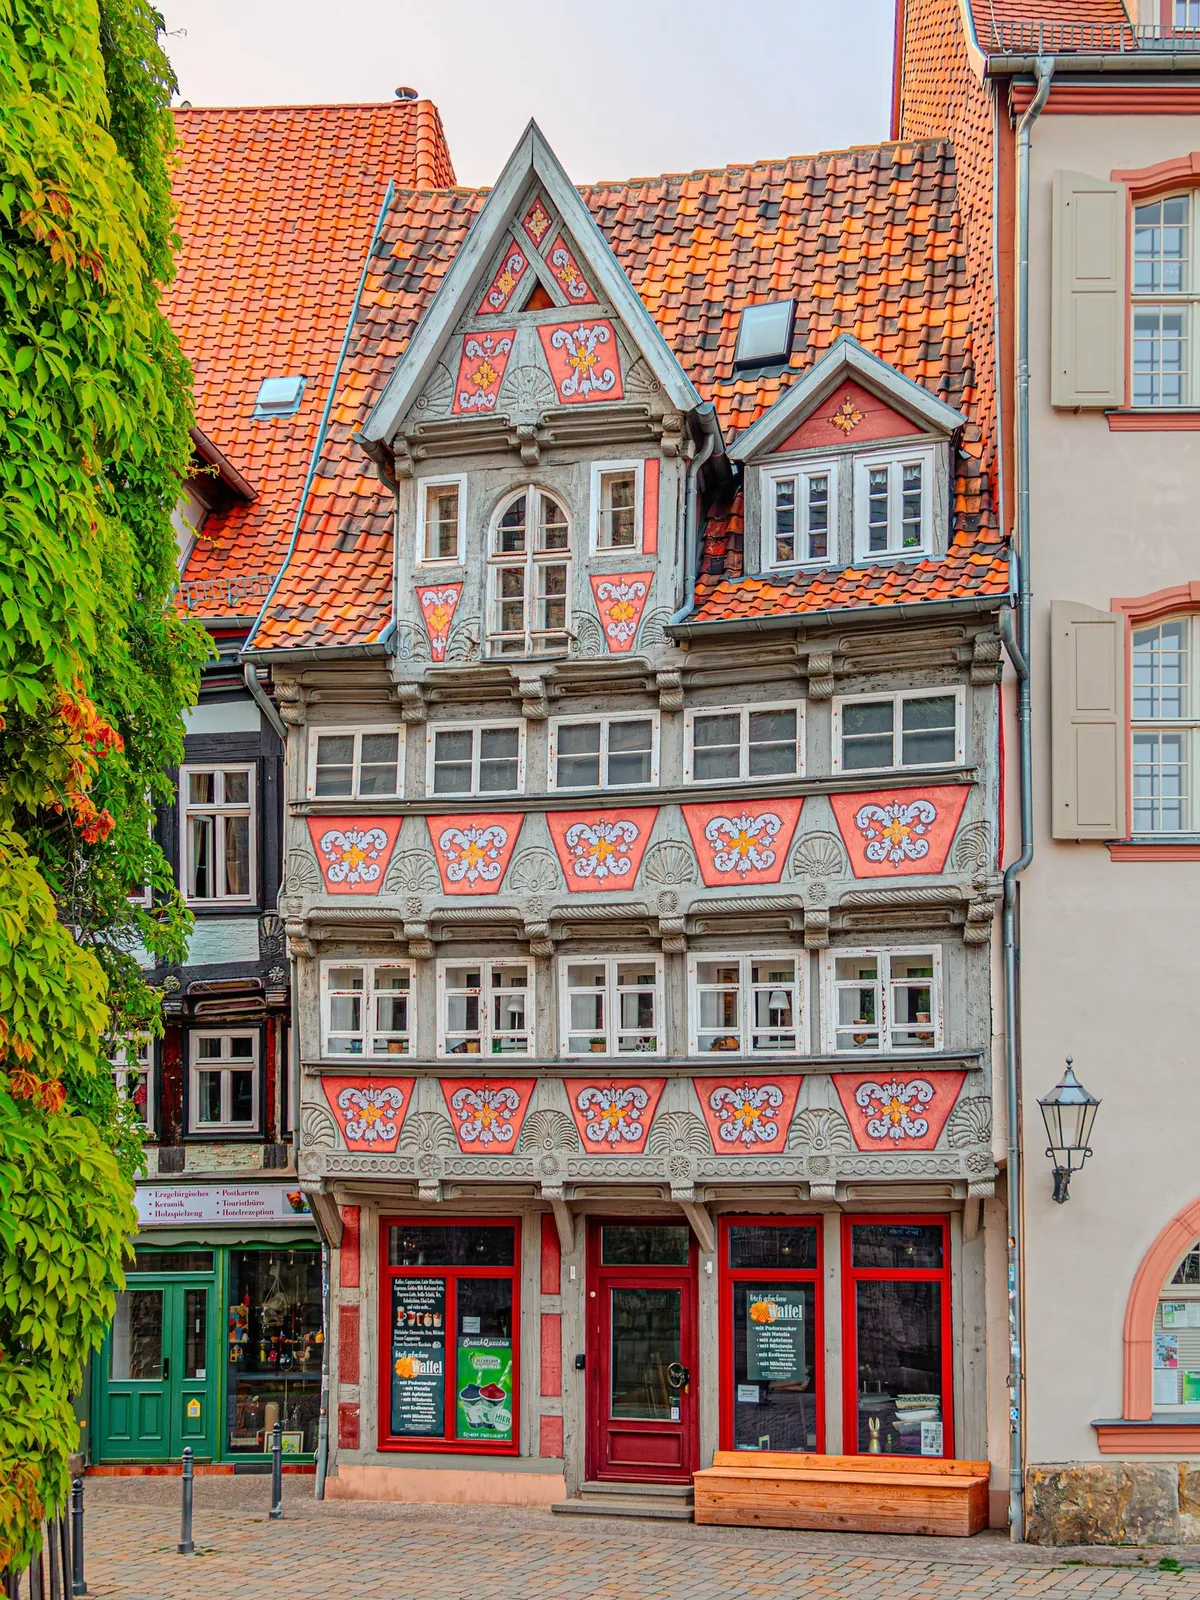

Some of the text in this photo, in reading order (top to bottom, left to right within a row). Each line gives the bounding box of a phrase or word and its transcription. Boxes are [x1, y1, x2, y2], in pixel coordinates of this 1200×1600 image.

[155, 1190, 209, 1200] Erzgebirgisches
[155, 1210, 203, 1218] Holzspielzeug
[222, 1208, 274, 1216] Hotelrezeption
[768, 1304, 802, 1318] Waffel
[412, 1360, 442, 1374] Waffel
[495, 1413, 511, 1424] HIER
